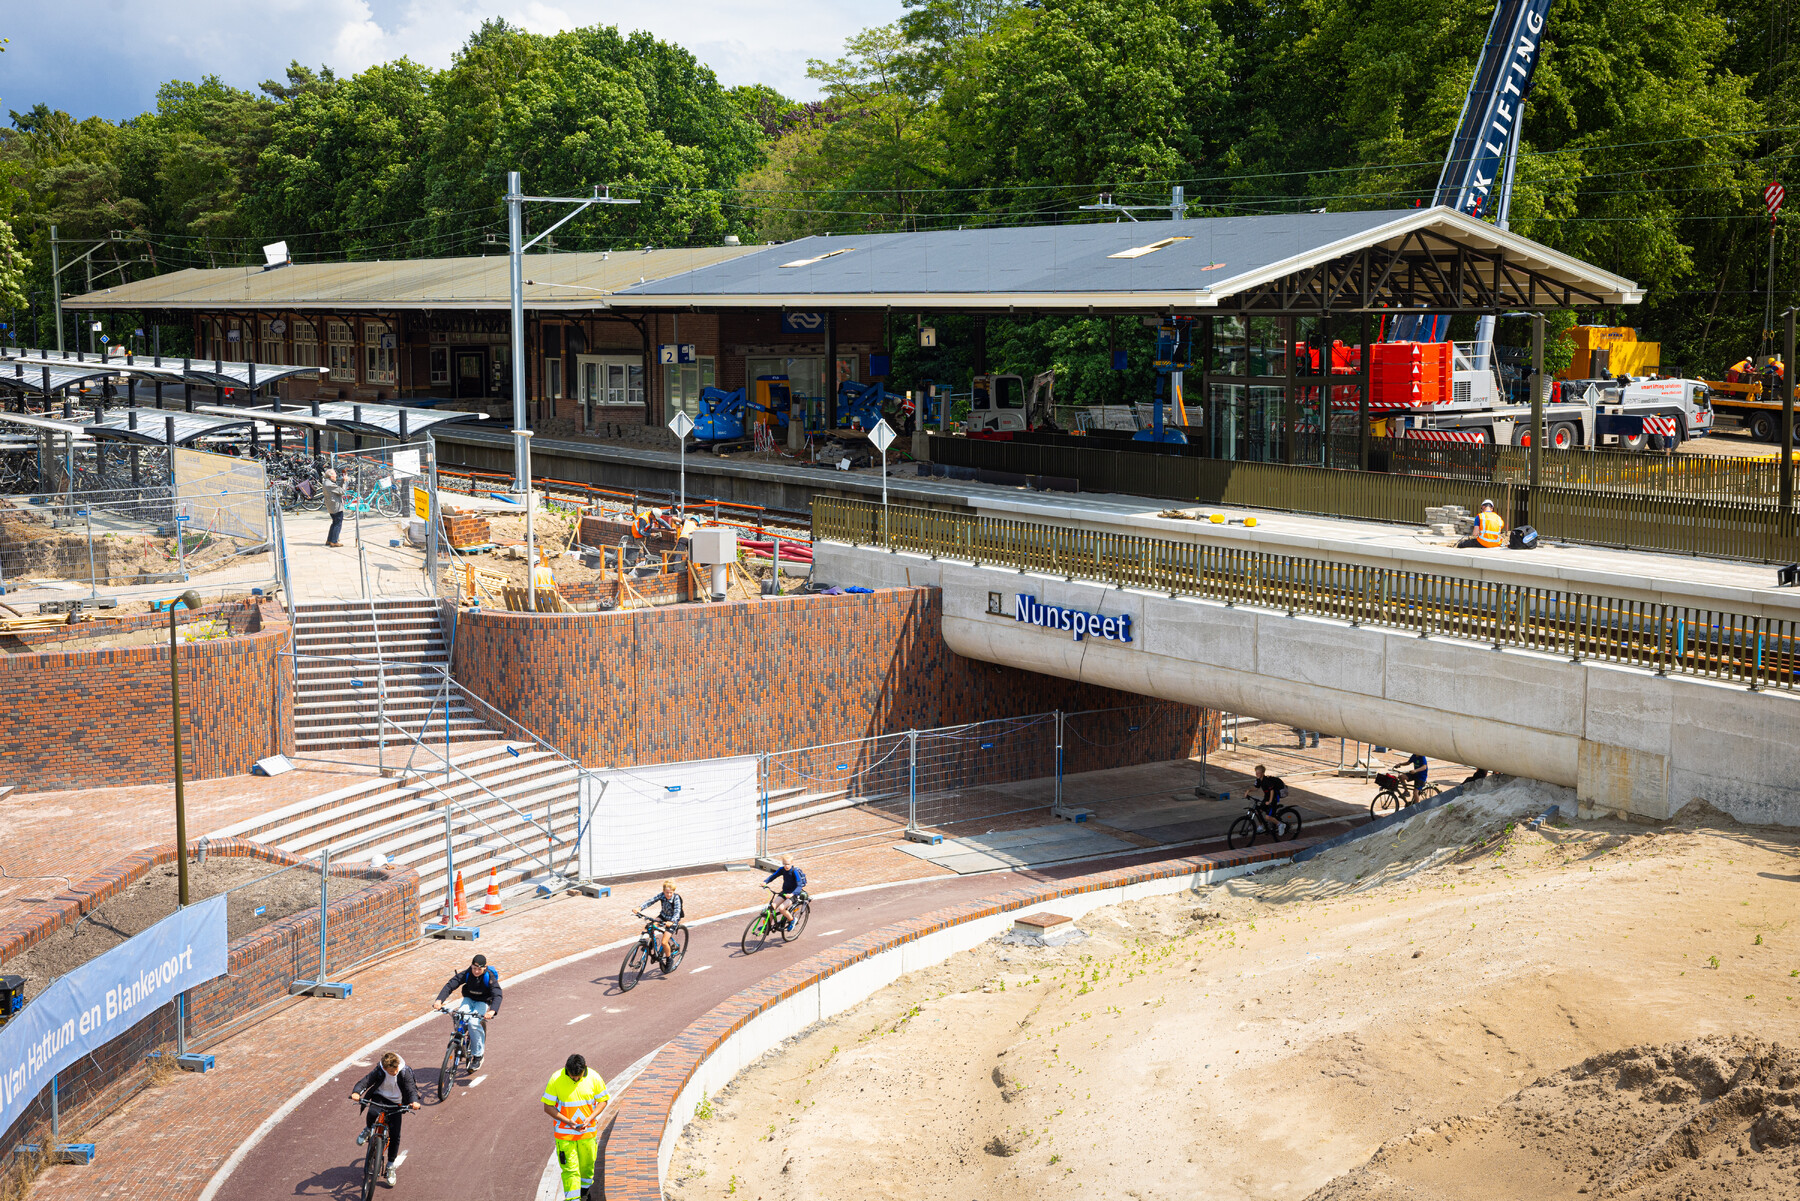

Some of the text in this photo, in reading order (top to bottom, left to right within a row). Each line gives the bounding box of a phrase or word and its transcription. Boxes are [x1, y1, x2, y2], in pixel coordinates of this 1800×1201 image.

[1486, 9, 1543, 157] LIFTING
[666, 351, 673, 363] 2
[1015, 593, 1131, 643] Nunspeet
[3, 944, 193, 1105] Van Hattum en Blankevoort
